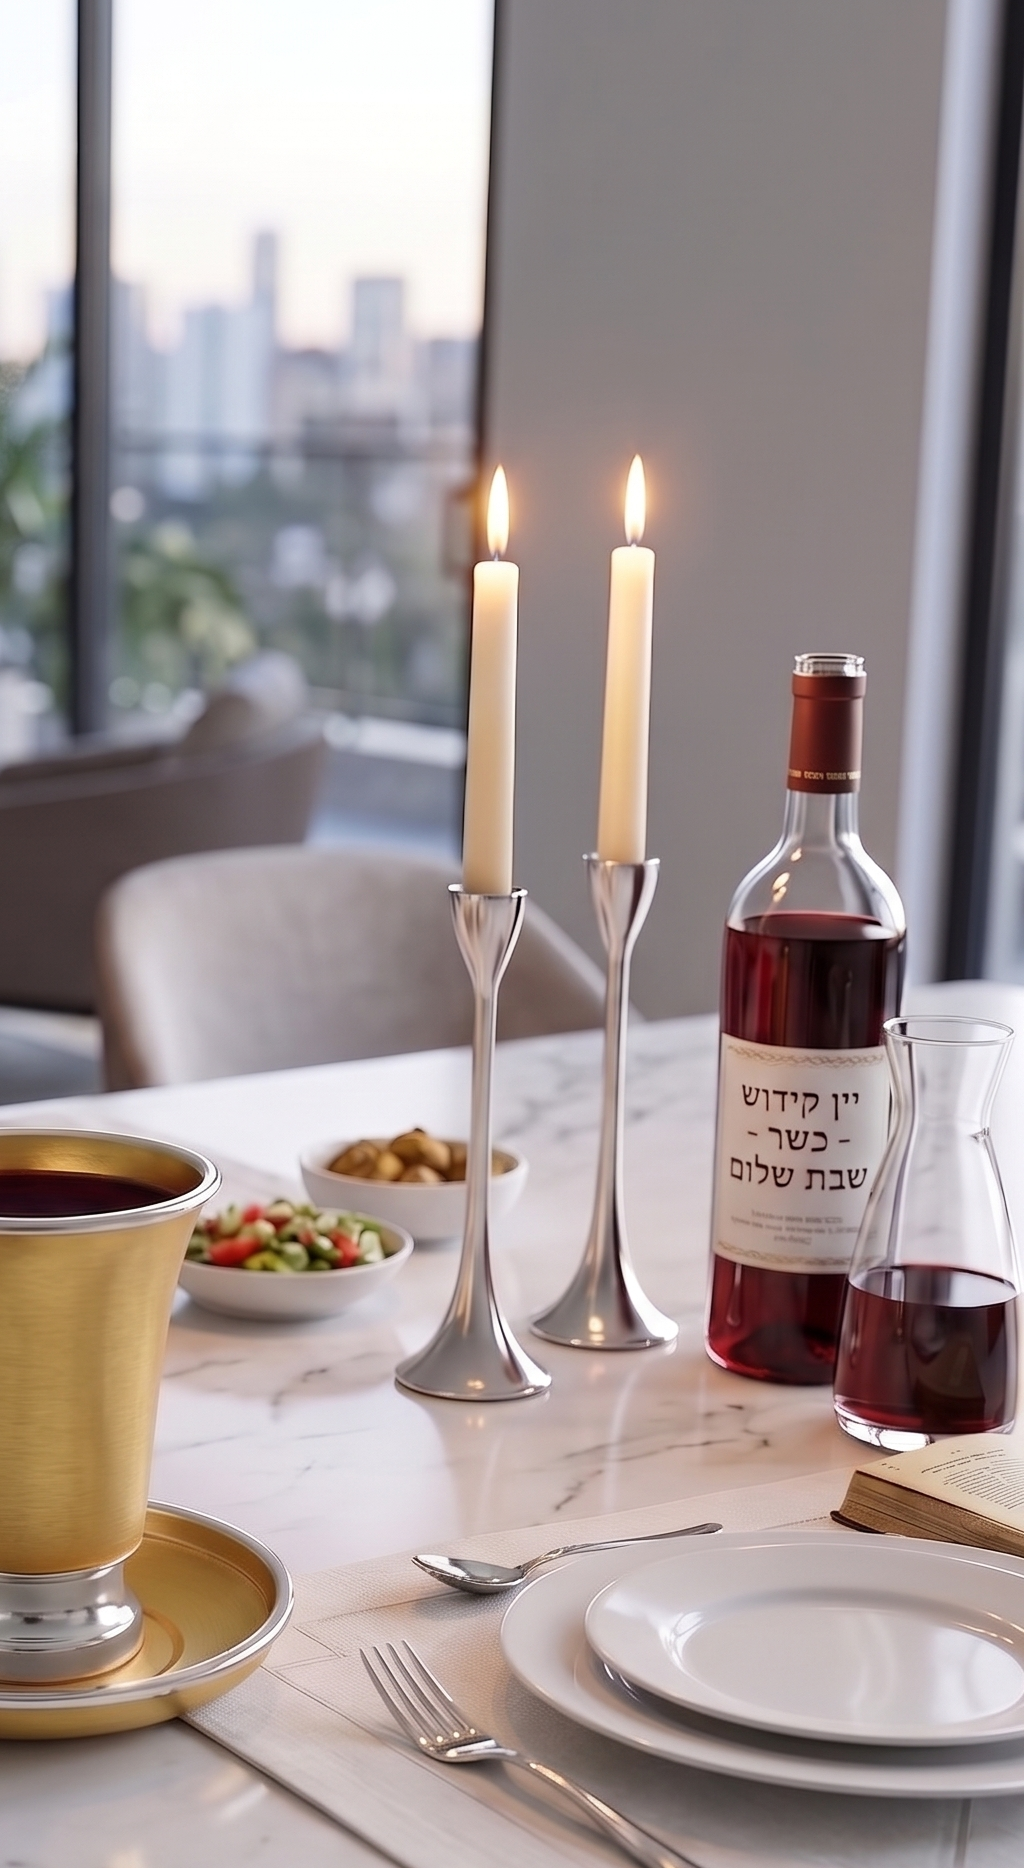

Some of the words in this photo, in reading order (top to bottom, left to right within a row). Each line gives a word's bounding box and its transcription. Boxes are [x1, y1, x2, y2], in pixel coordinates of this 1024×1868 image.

[741, 1084, 820, 1119] קידוש
[831, 1092, 860, 1122] יין
[767, 1126, 828, 1153] כשר
[730, 1153, 795, 1189] שלום
[804, 1167, 868, 1191] שבת
